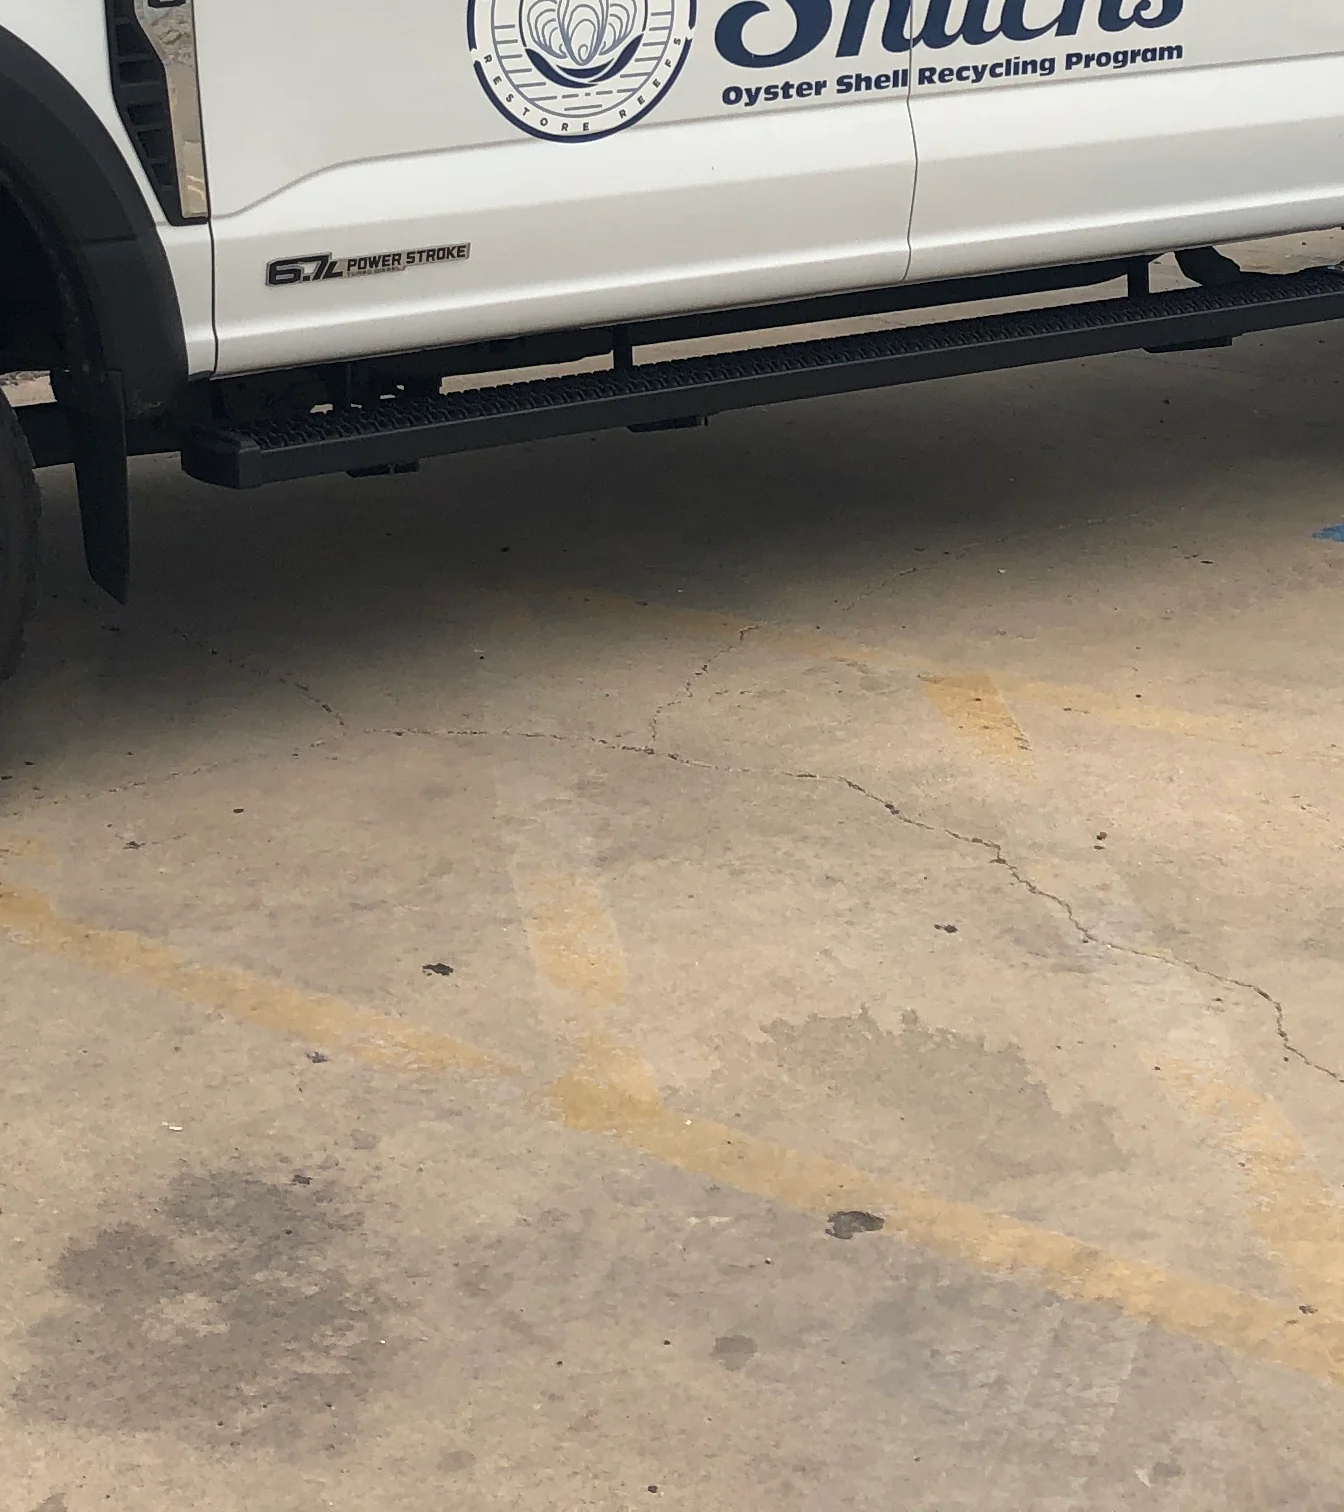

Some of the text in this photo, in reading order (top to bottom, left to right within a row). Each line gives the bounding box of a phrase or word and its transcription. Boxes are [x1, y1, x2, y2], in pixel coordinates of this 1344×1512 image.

[484, 38, 682, 132] RESTORE REEFS
[722, 43, 1184, 107] Oyster Shell Recycling Program
[268, 254, 344, 286] 6.7L
[346, 252, 402, 272] POWER
[406, 244, 467, 265] STROKE
